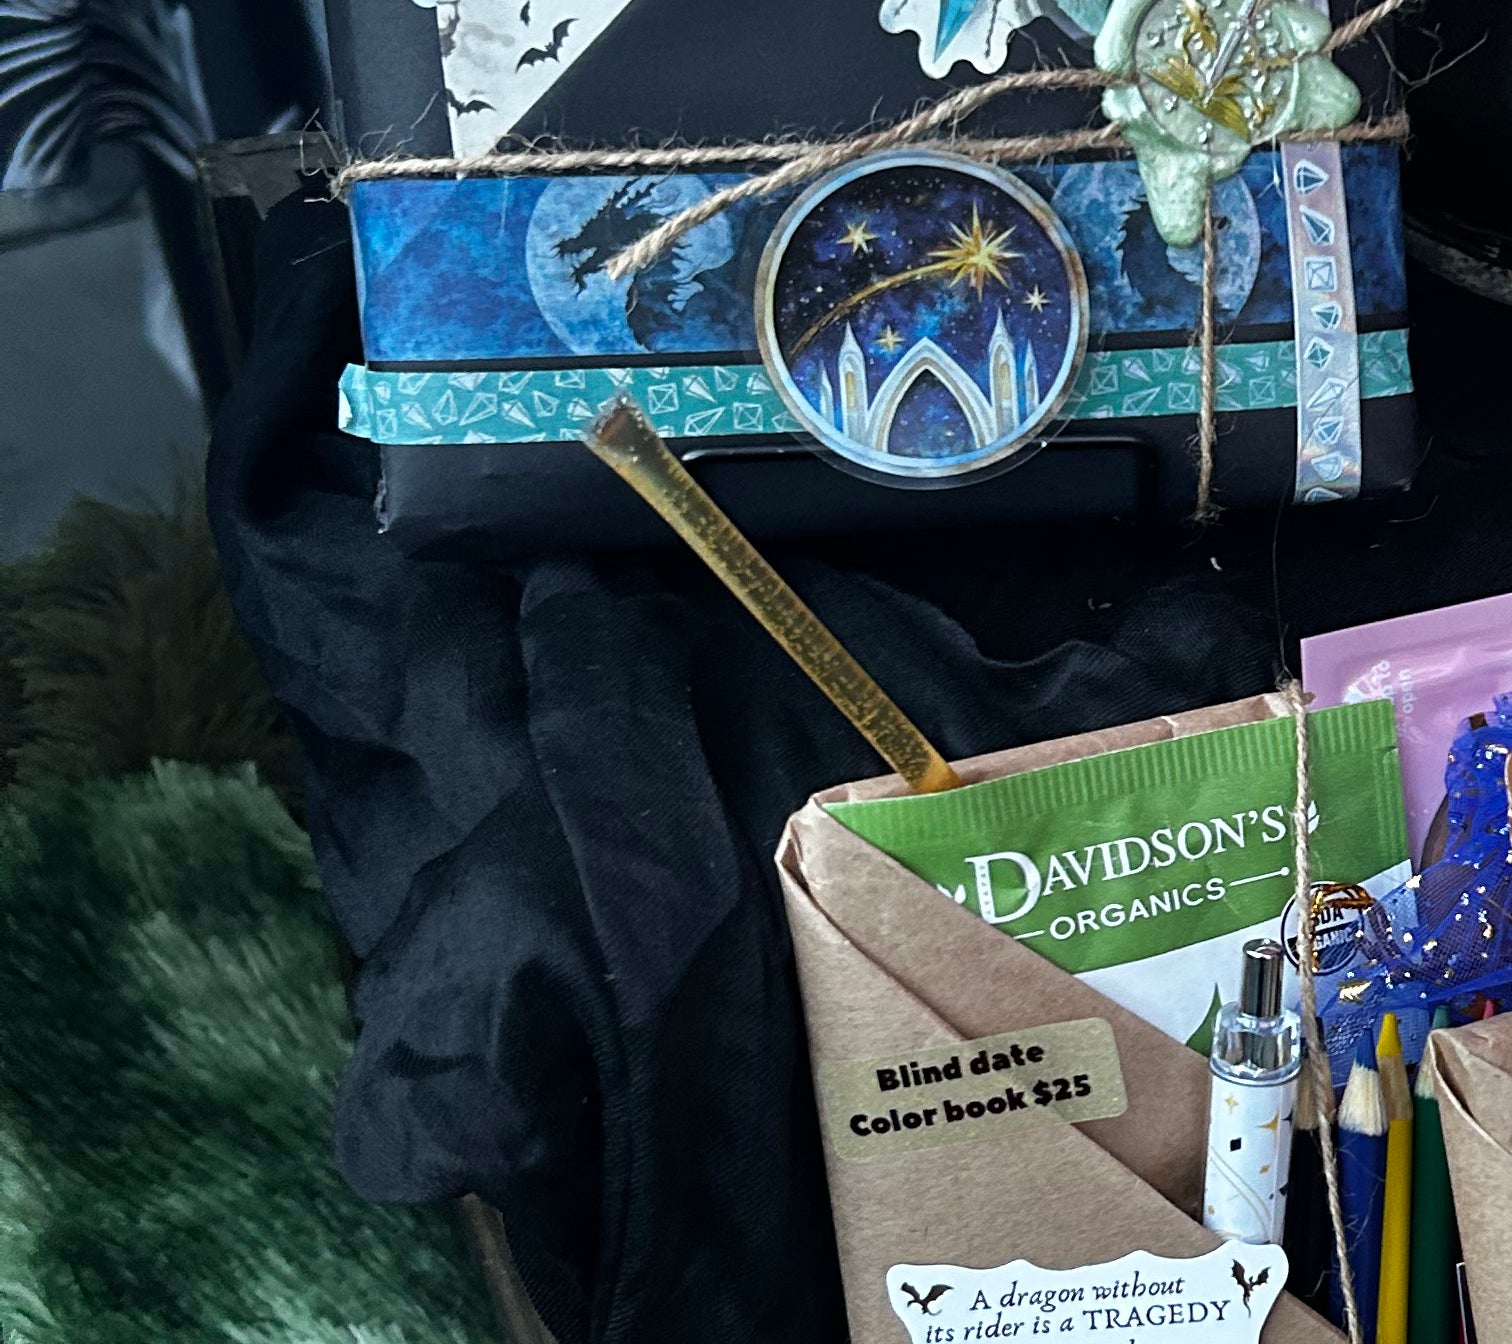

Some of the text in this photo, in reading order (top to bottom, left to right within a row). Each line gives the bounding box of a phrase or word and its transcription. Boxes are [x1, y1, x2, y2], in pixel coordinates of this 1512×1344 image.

[964, 805, 1286, 925] DAVIDSON'S
[1049, 878, 1227, 942] ORGANICS
[876, 1043, 1044, 1092] Blind date
[849, 1074, 1091, 1137] Color book $25
[969, 1271, 1185, 1312] A dragon without
[925, 1300, 1231, 1344] its rider is a TRAGEDY
